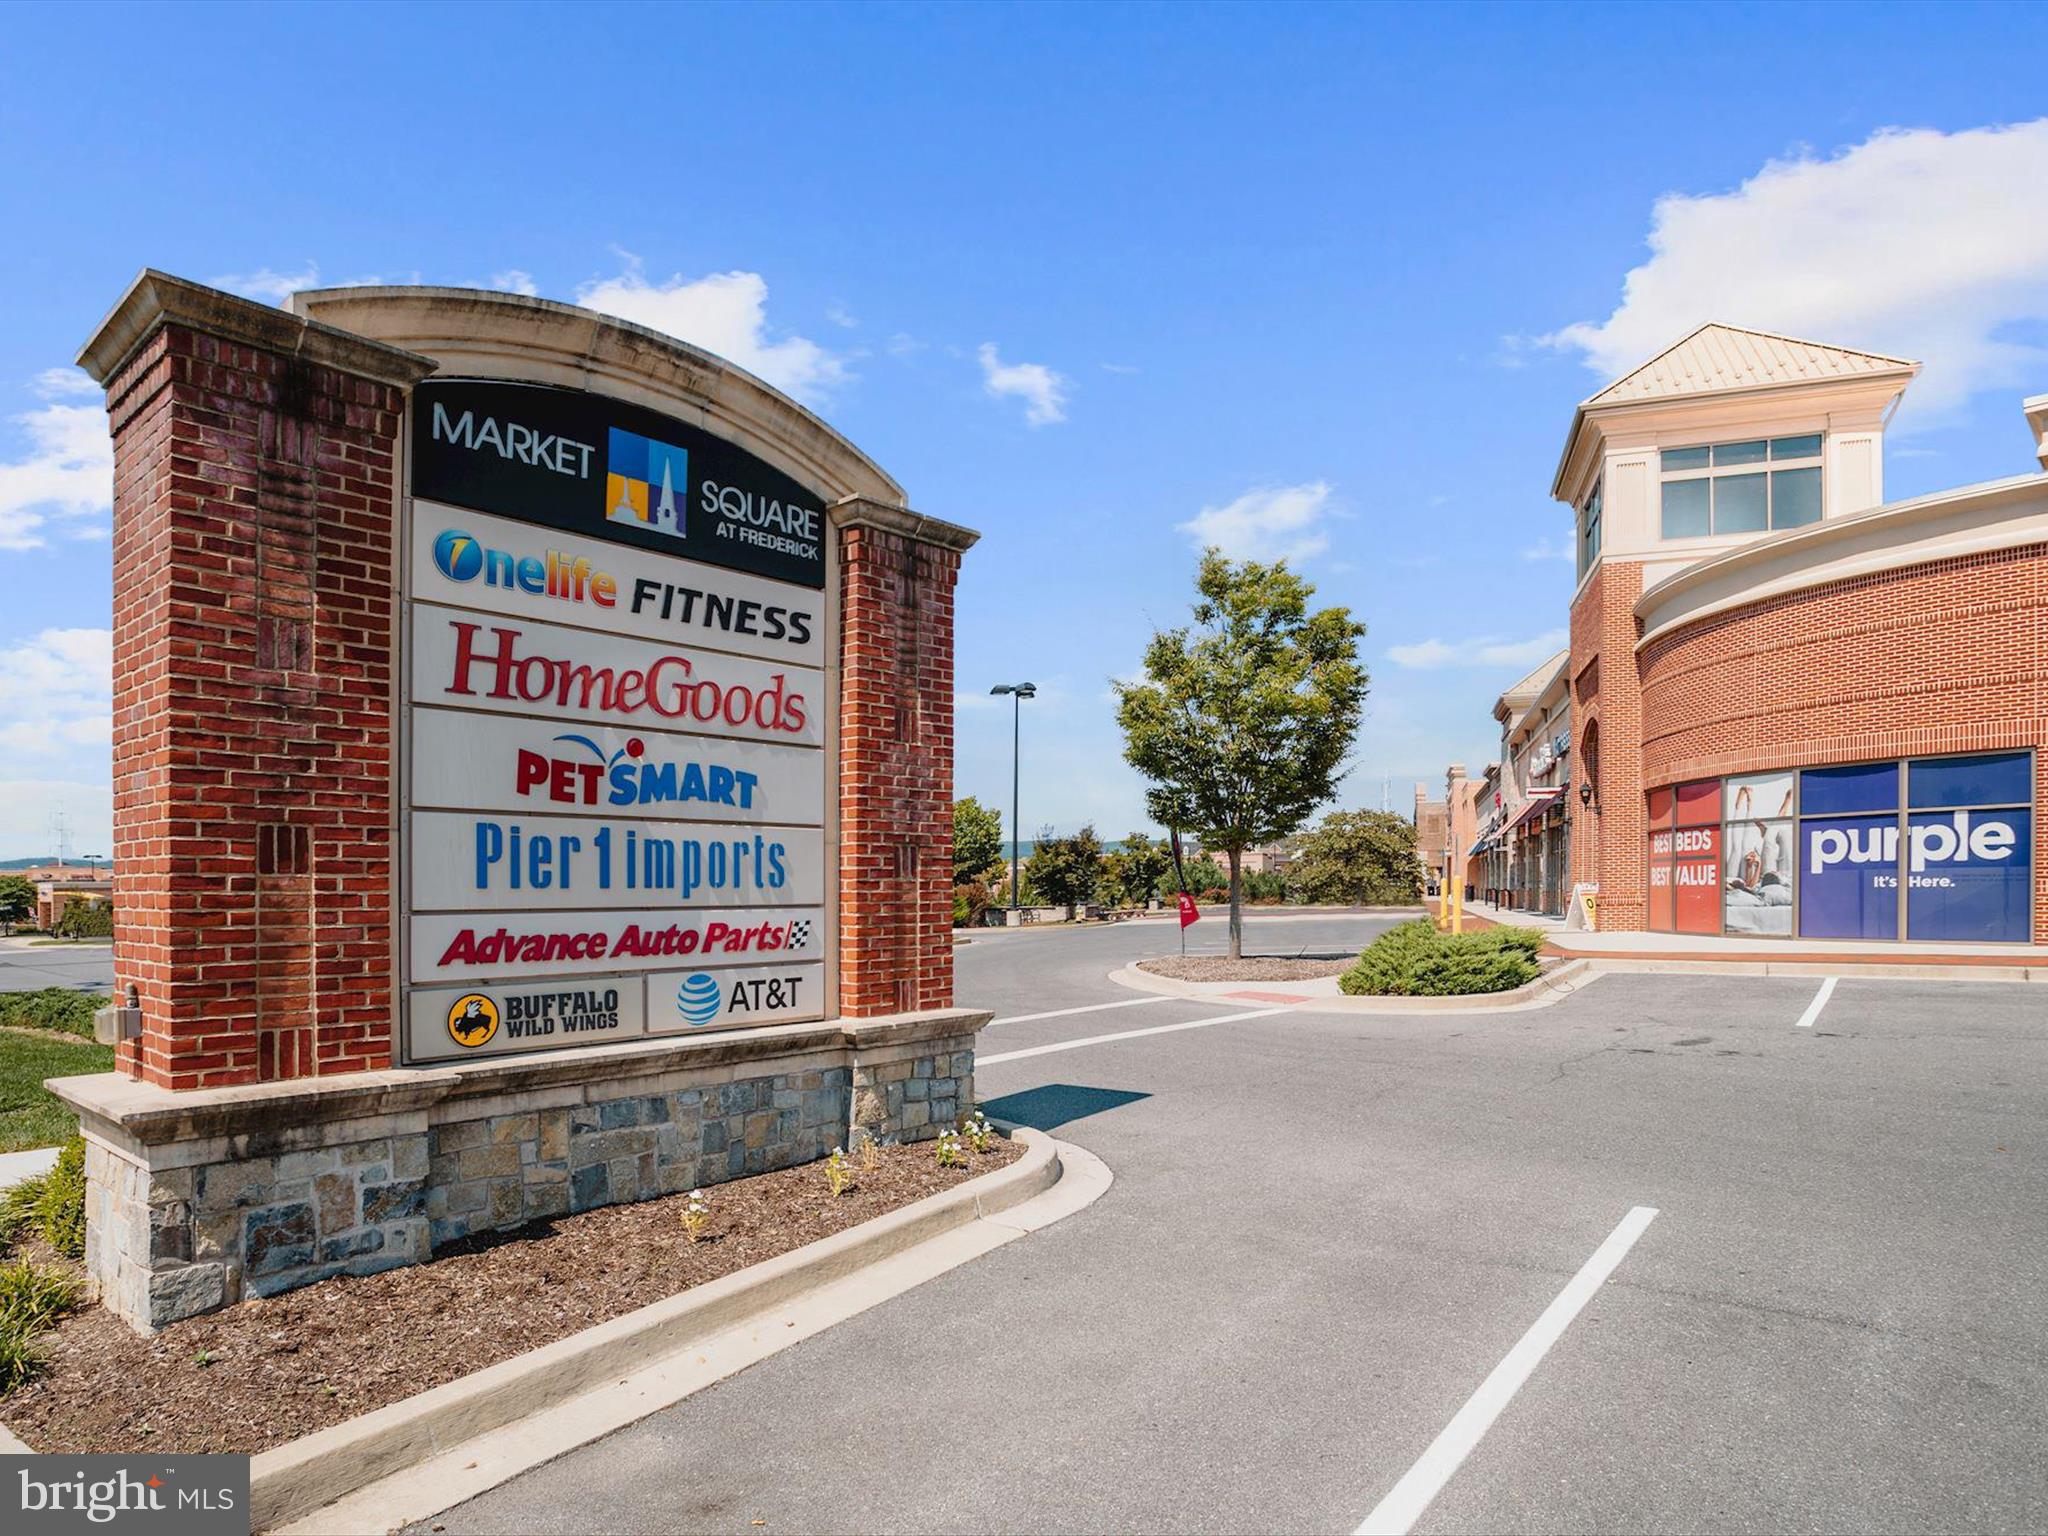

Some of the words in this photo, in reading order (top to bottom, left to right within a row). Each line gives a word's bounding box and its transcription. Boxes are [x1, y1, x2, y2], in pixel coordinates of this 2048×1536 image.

[432, 402, 595, 479] MARKET
[701, 480, 819, 541] SQUARE
[716, 521, 737, 540] AT
[739, 528, 819, 561] FREDERICK
[432, 528, 618, 608] Onelife
[630, 577, 812, 645] FITNESS
[444, 621, 806, 733] HomeGoods
[475, 822, 581, 889] Pier
[594, 827, 611, 889] 1
[626, 831, 786, 899] imports
[1654, 833, 1672, 853] BEST
[1676, 829, 1712, 852] BEDS
[1811, 811, 2016, 874] purple
[1651, 866, 1671, 886] BEST
[1873, 876, 1898, 888] It's
[1909, 876, 1955, 888] Here.
[438, 928, 608, 967] Advance
[609, 924, 700, 958] Auto
[701, 920, 784, 954] Parts
[504, 989, 619, 1021] BUFFALO
[728, 977, 803, 1013] AT&T
[505, 1019, 554, 1039] WILD
[563, 1011, 619, 1033] WINGS
